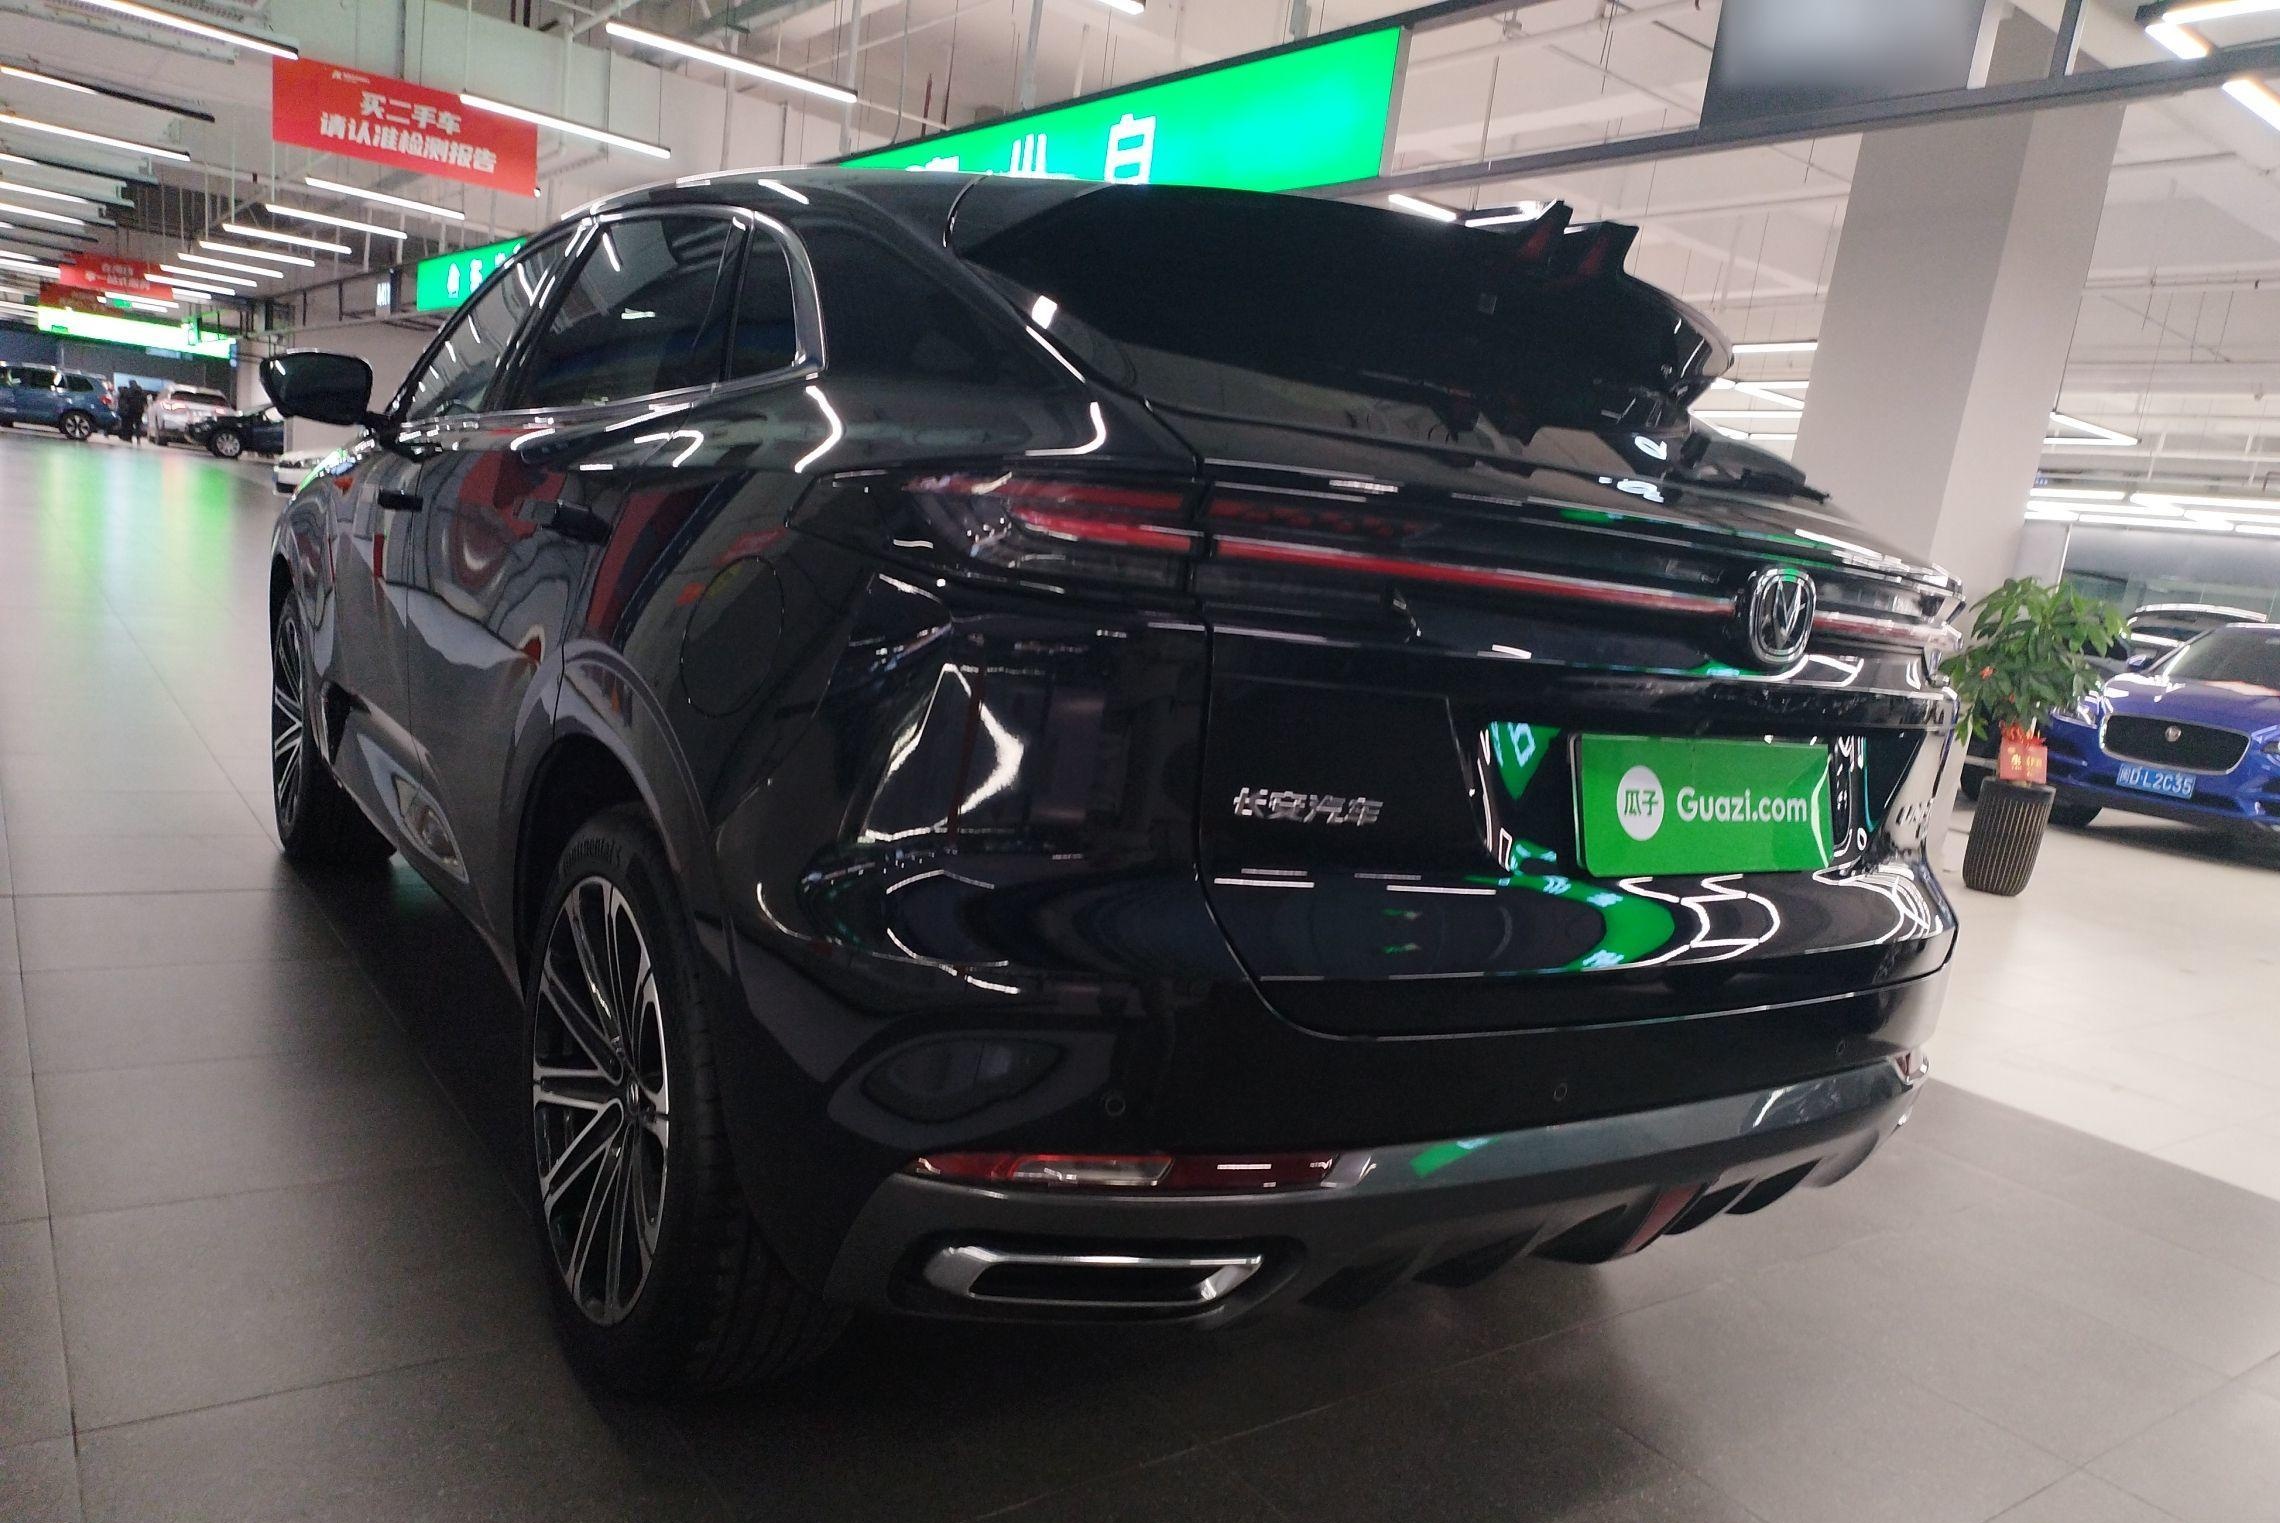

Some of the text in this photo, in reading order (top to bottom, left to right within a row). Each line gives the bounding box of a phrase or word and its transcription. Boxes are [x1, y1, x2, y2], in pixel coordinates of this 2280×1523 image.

[361, 90, 462, 135] 买二手车
[320, 112, 496, 173] 请认准检测报告
[1233, 787, 1383, 826] 长安汽车
[1623, 786, 1807, 823] 瓜子 Guazi.com
